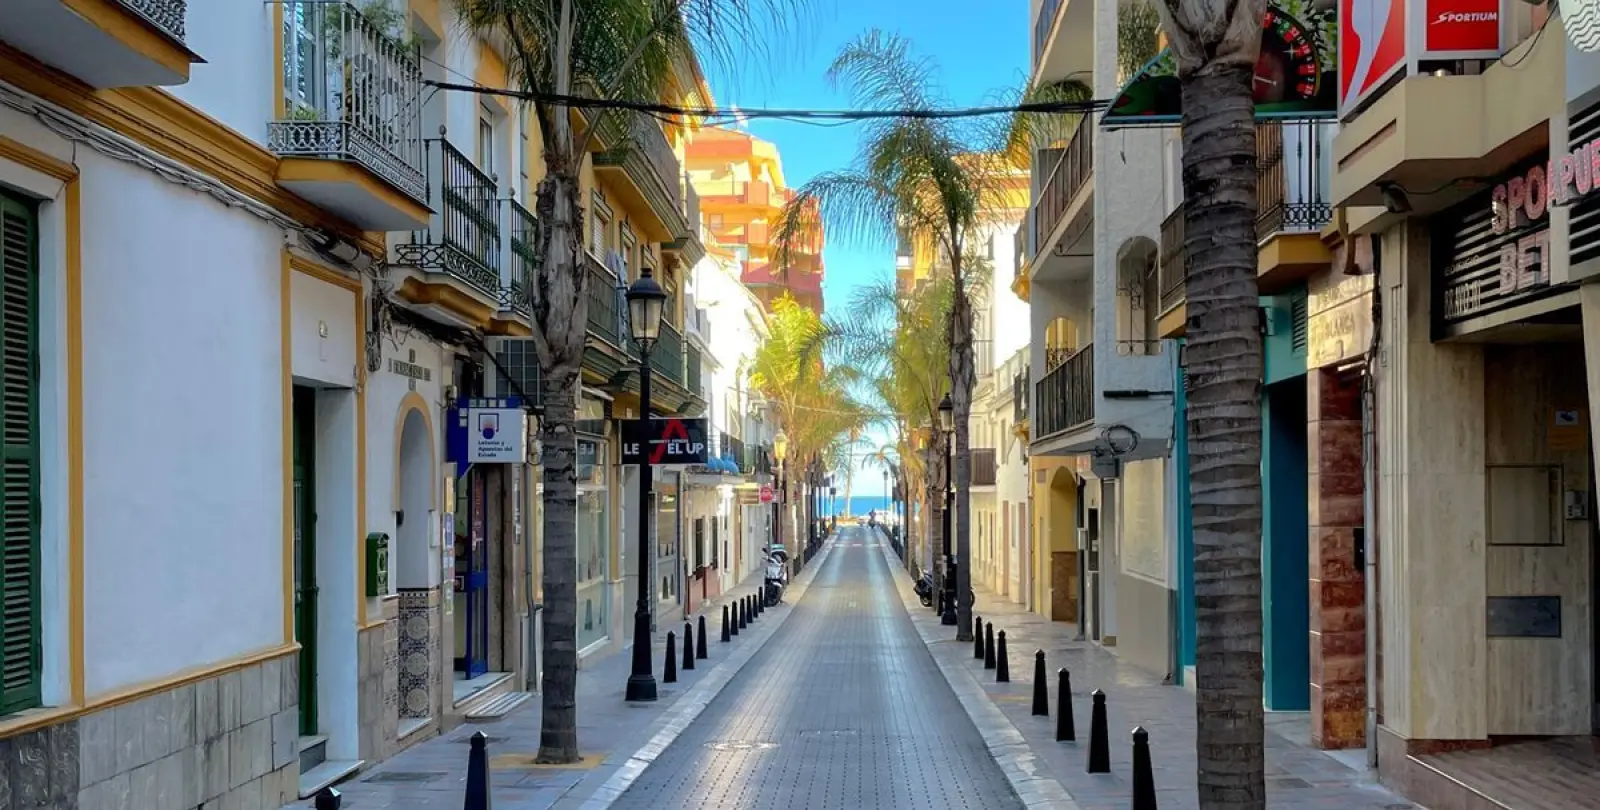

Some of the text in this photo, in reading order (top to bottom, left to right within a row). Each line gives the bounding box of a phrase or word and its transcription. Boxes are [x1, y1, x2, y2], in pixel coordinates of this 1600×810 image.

[1431, 11, 1498, 24] SPORTIUM
[1500, 228, 1550, 296] BET
[686, 441, 704, 454] UP
